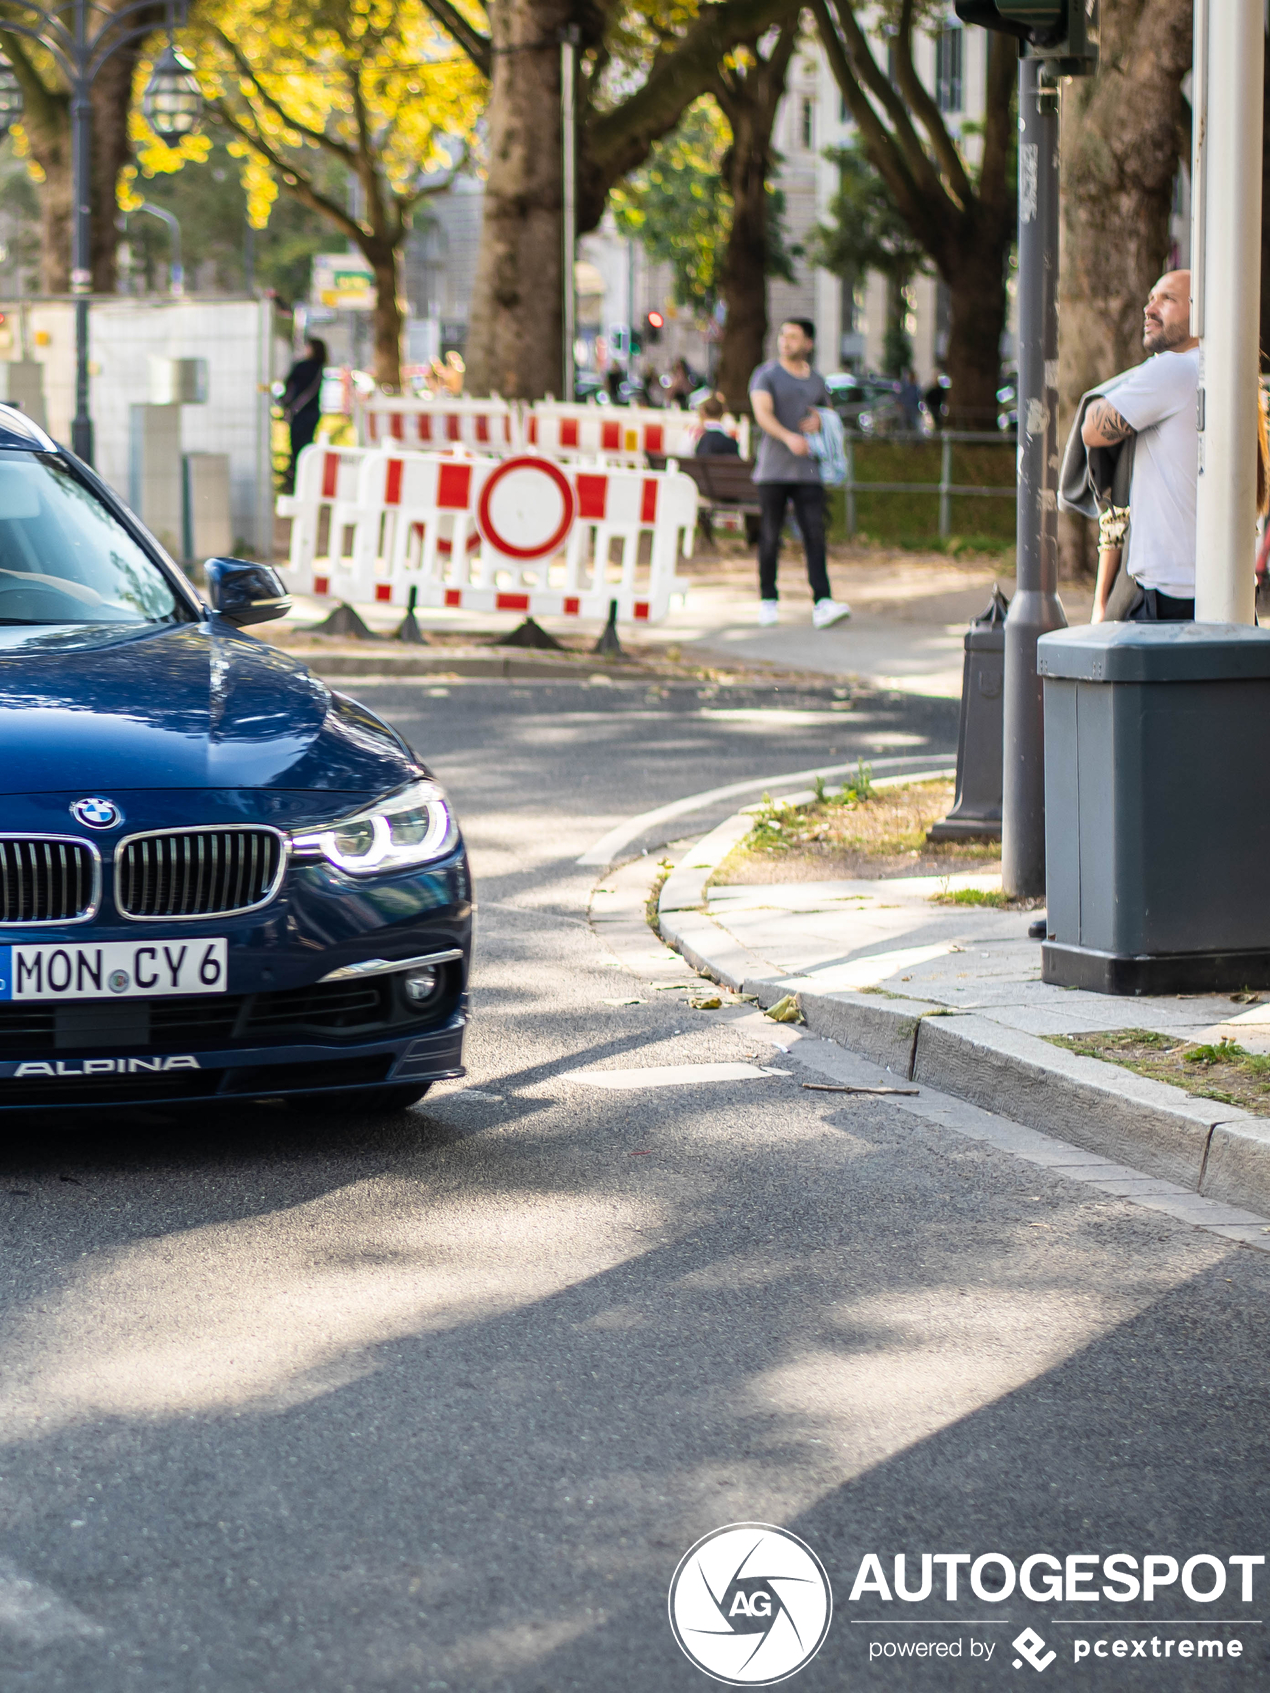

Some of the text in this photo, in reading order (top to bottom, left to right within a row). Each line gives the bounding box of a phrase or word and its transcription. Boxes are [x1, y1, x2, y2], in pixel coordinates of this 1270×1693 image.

[16, 944, 221, 993] MON CY 6
[13, 1055, 201, 1077] ALPINA
